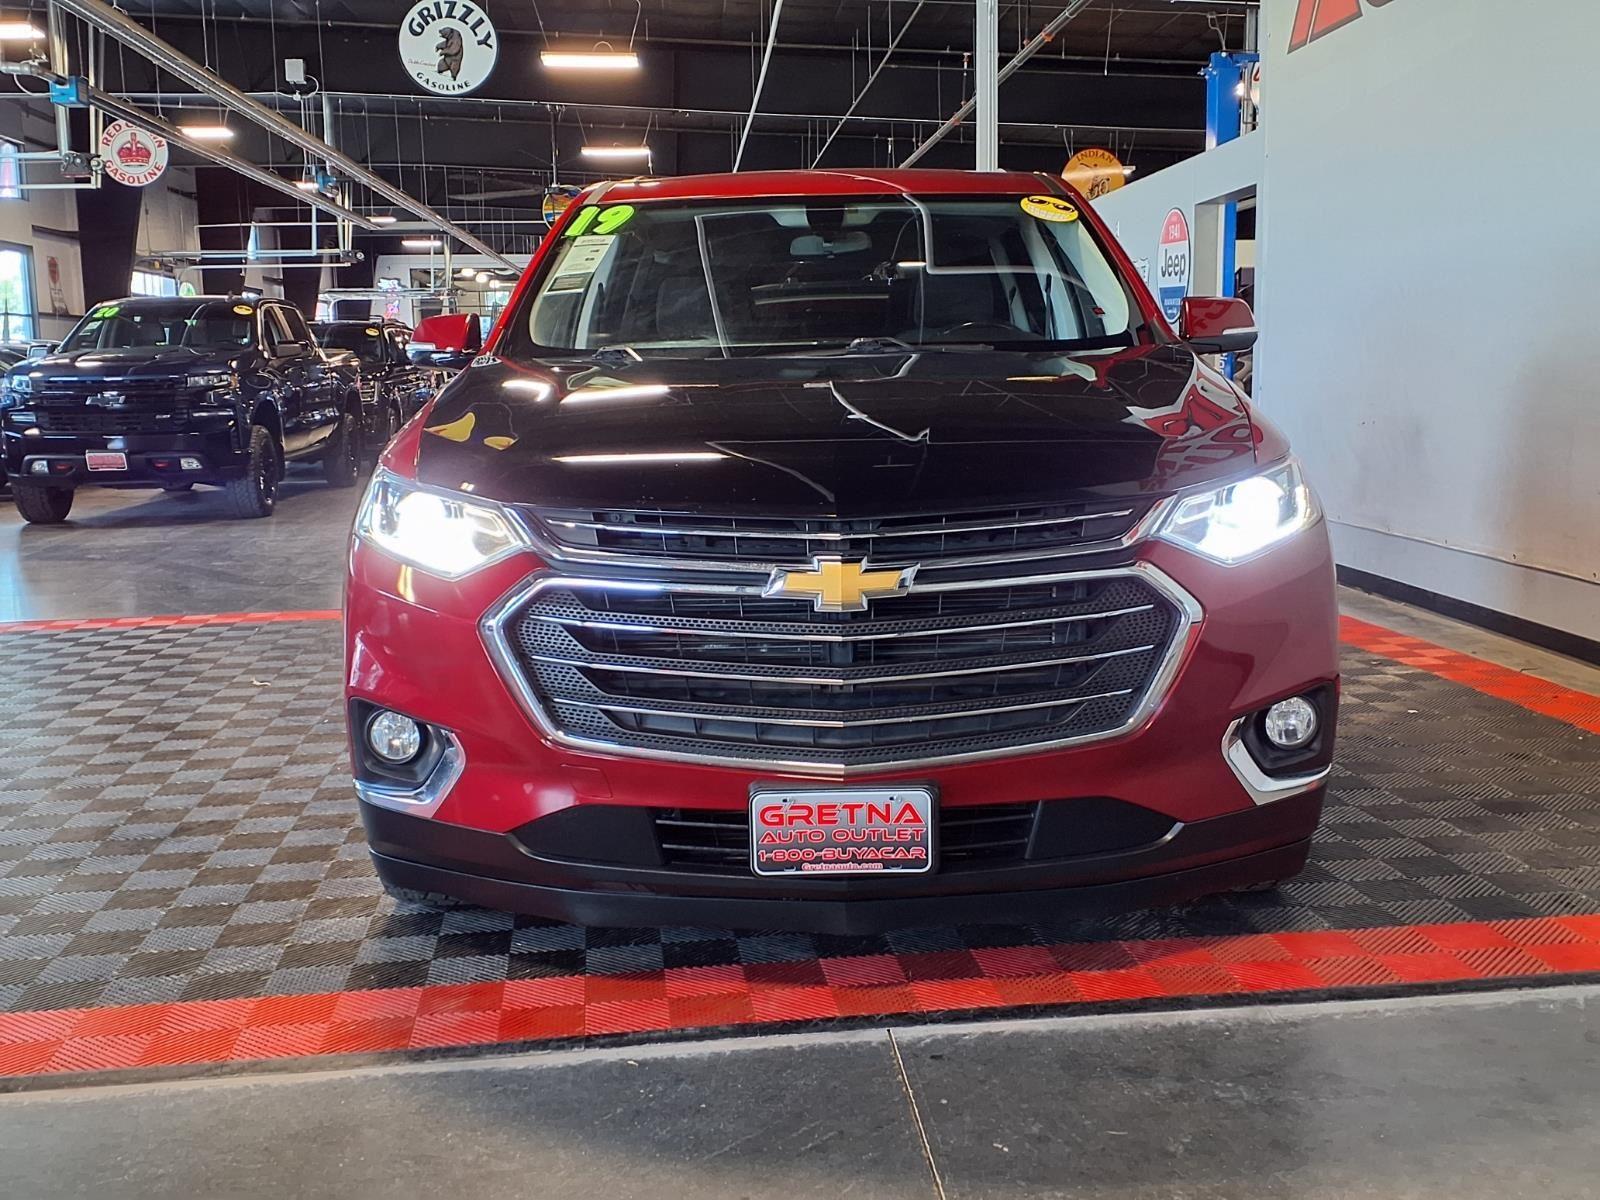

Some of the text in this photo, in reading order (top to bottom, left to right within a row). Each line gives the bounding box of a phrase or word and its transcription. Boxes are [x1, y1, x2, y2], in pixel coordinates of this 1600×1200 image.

[408, 1, 493, 49] GRIZZLY
[416, 72, 471, 91] GASOLINE
[102, 123, 122, 146] RED
[1076, 150, 1115, 164] INDIAN
[105, 160, 164, 184] GASOLINE
[564, 205, 635, 237] 19
[1168, 223, 1181, 240] 1941
[1161, 248, 1186, 283] Jeep
[93, 306, 120, 320] 20
[759, 802, 925, 827] GRETNA
[759, 827, 926, 844] AUTO OUTLET
[758, 846, 926, 862] 1-800-BUYACAR
